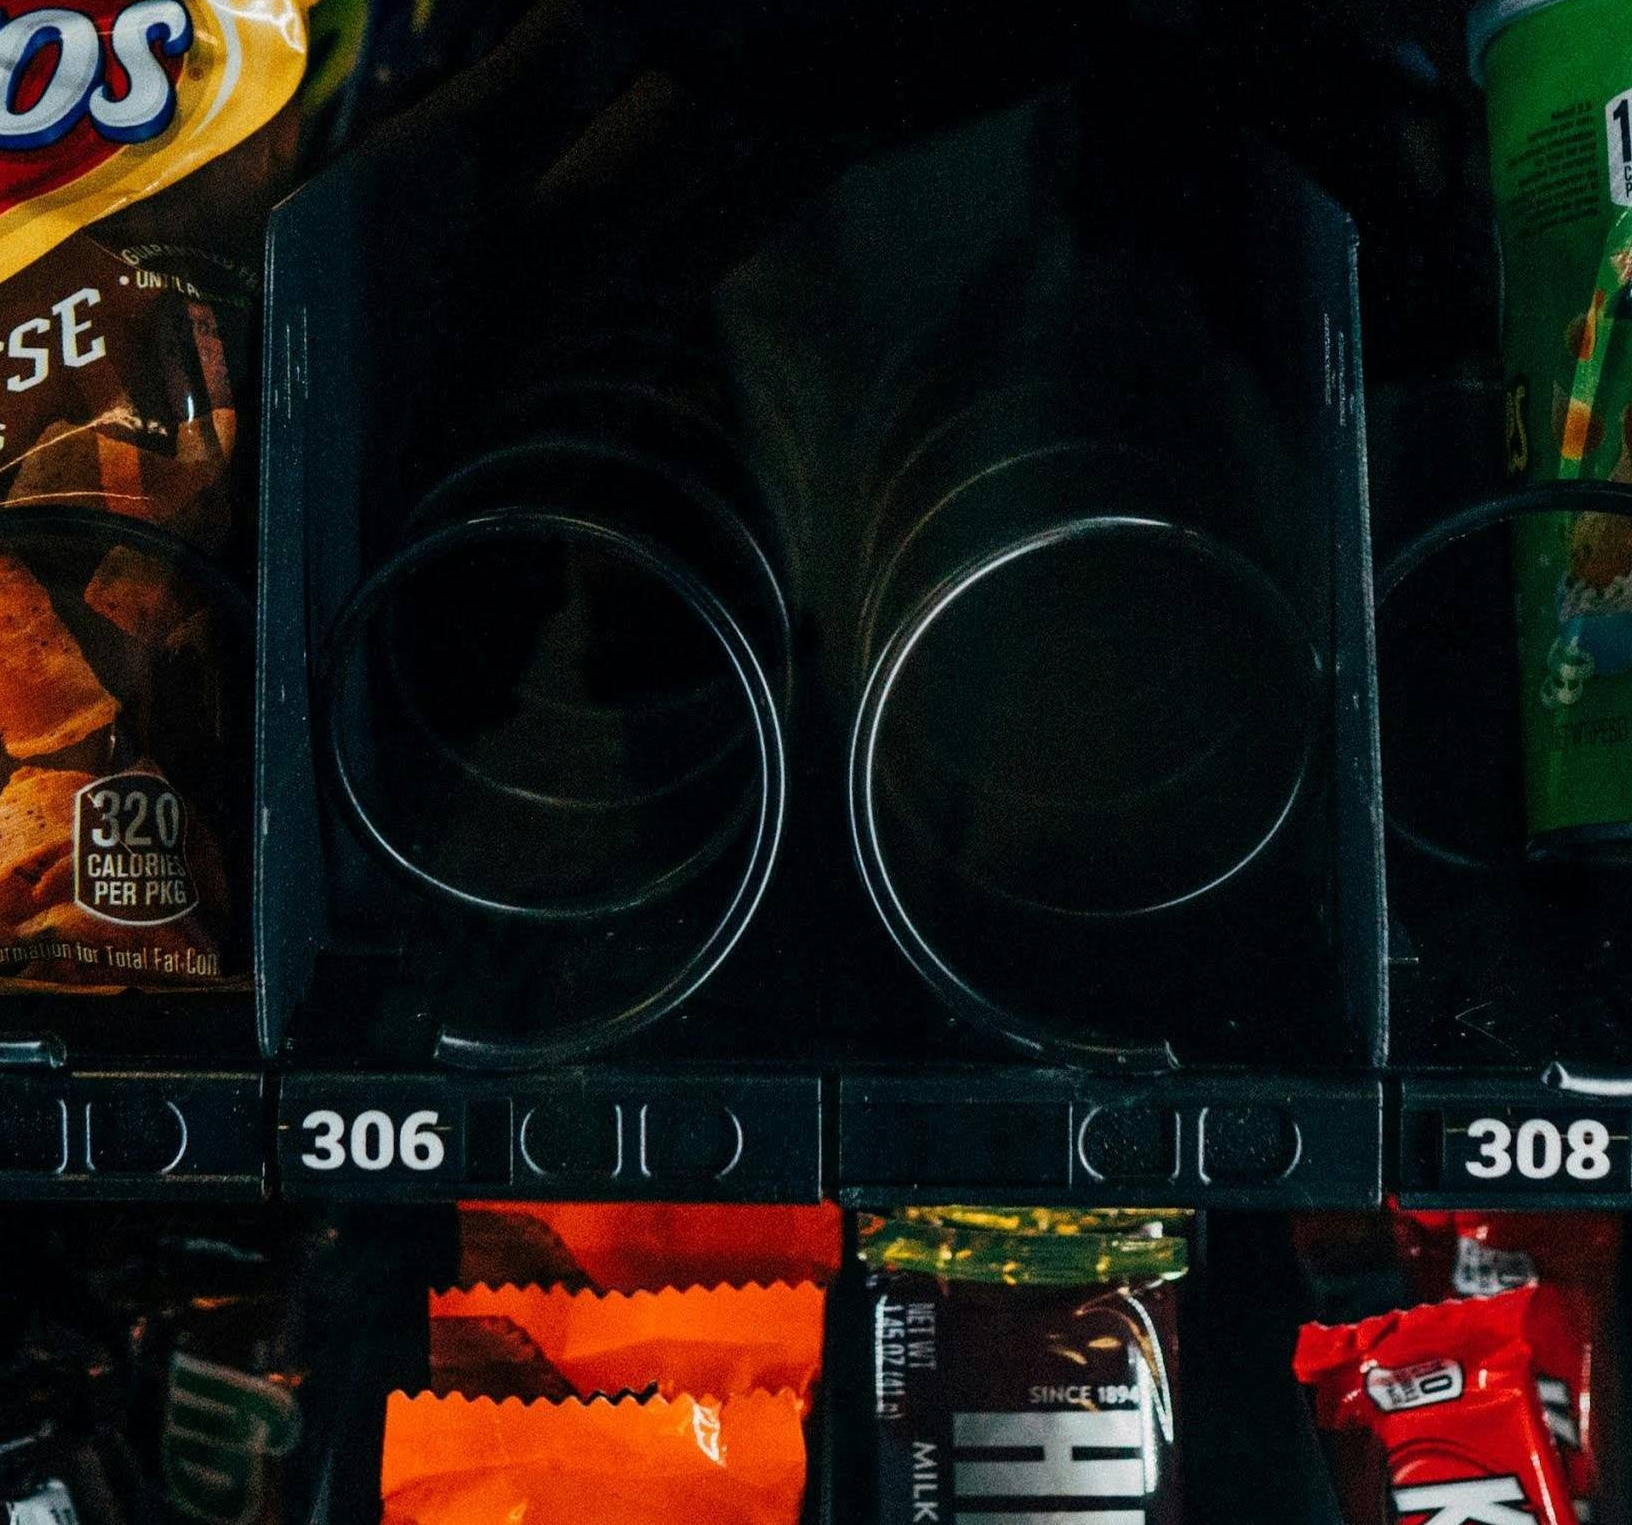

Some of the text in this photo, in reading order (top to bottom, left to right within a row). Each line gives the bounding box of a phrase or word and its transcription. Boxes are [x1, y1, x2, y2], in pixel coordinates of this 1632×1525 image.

[90, 789, 180, 849] 320
[86, 852, 187, 878] CALORIES
[93, 879, 188, 906] PER PKG
[104, 944, 147, 971] Total
[299, 1108, 447, 1172] 306
[1463, 1117, 1613, 1181] 308
[1028, 1384, 1140, 1405] SINCE 1894
[911, 1440, 940, 1523] MILK
